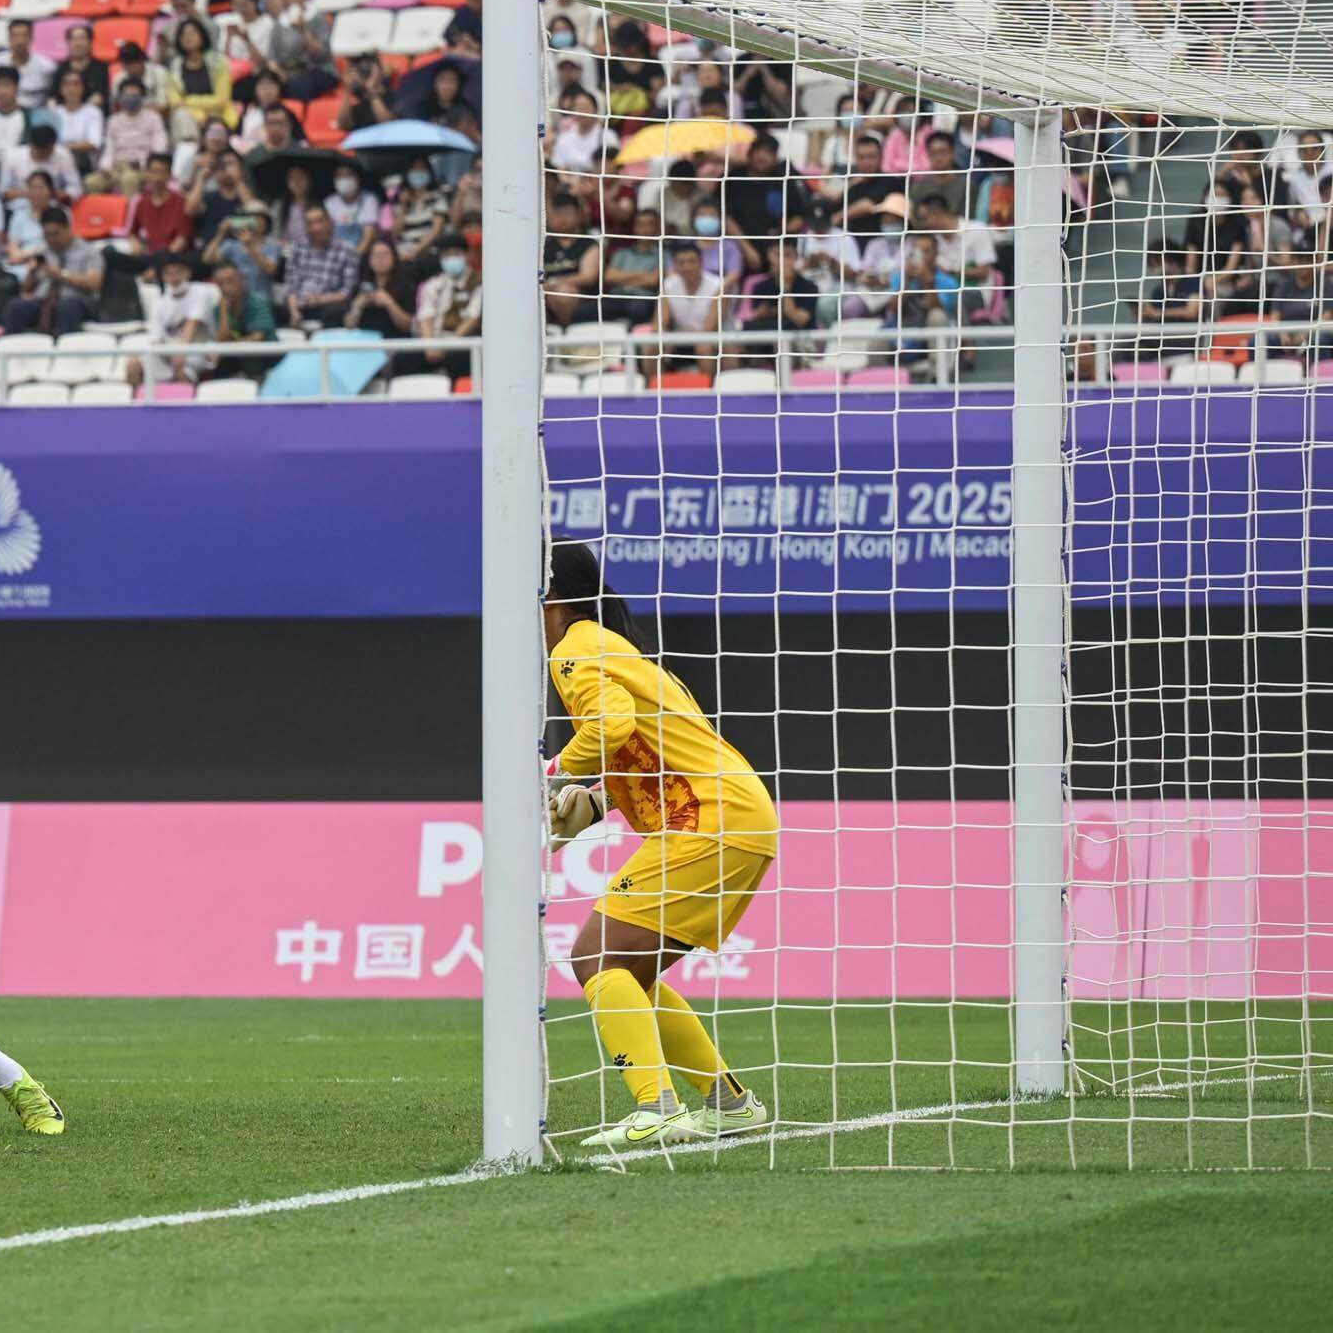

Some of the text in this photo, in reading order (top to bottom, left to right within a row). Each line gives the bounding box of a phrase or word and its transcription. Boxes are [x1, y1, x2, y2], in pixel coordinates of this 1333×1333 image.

[906, 481, 1013, 525] 2025
[772, 535, 838, 565] Hong
[844, 534, 910, 565] Kong
